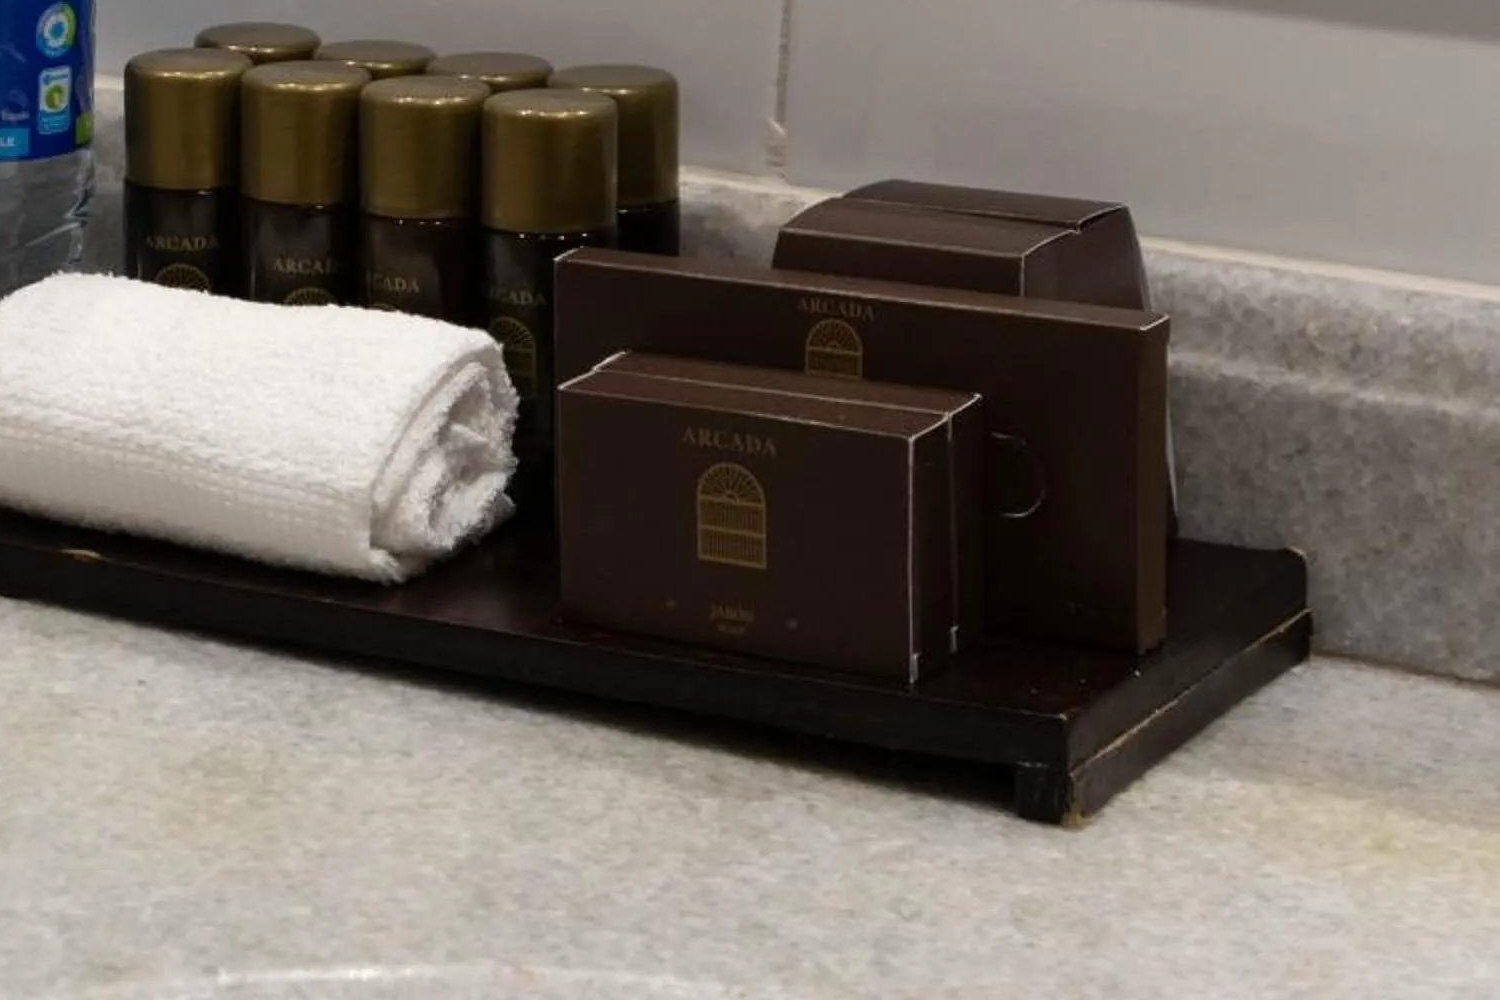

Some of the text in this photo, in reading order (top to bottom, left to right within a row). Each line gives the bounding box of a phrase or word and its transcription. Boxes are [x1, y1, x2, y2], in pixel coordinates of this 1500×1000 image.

[145, 233, 220, 252] ARCADA
[798, 297, 875, 322] ARCADA
[683, 425, 777, 459] ARCADA
